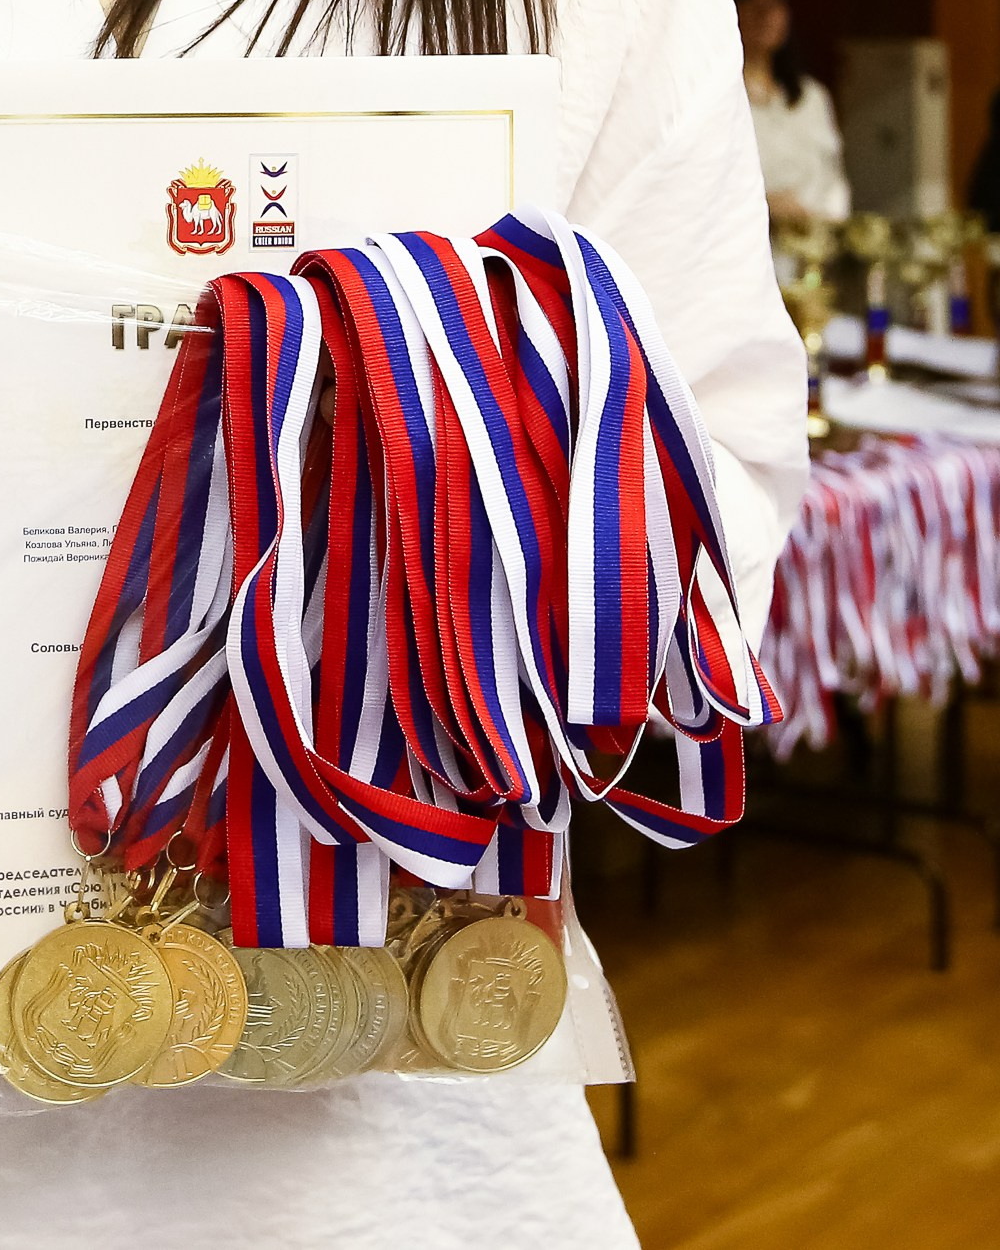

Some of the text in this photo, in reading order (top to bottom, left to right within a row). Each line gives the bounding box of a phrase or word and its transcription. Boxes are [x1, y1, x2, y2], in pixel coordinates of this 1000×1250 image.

[255, 225, 293, 234] RUSSIAN
[111, 303, 196, 350] ГРА
[85, 418, 157, 431] Первенств
[23, 527, 66, 536] Беликова
[67, 526, 110, 536] Валерия,
[25, 541, 63, 549] Козлова
[65, 539, 100, 549] Ульяна,
[23, 554, 64, 563] Пожидай
[48, 807, 69, 820] суд
[48, 904, 55, 913] в
